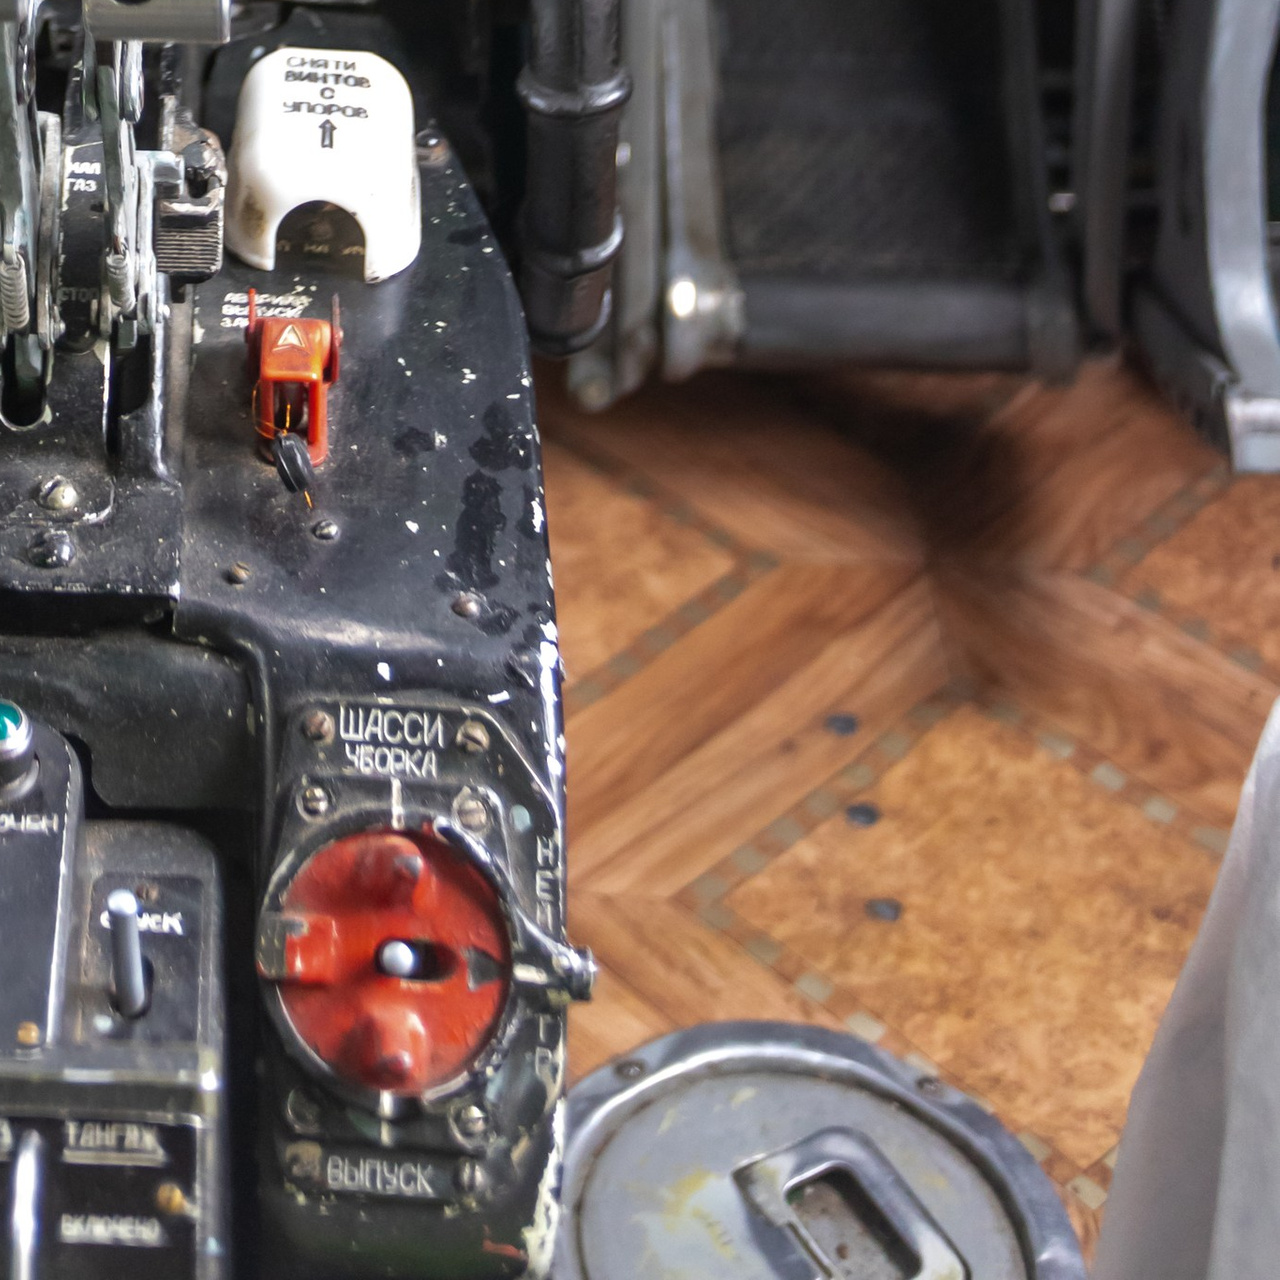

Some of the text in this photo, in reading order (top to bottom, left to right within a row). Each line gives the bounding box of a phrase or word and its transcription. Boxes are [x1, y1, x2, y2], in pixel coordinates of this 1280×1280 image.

[284, 71, 372, 89] ВИНТОВ
[282, 100, 369, 119] УПОРОВ
[338, 702, 446, 749] ШАССИ
[344, 742, 438, 779] УБОРКА
[64, 1121, 163, 1152] ТАНГАЖ
[326, 1154, 437, 1198] ВЫПУСК
